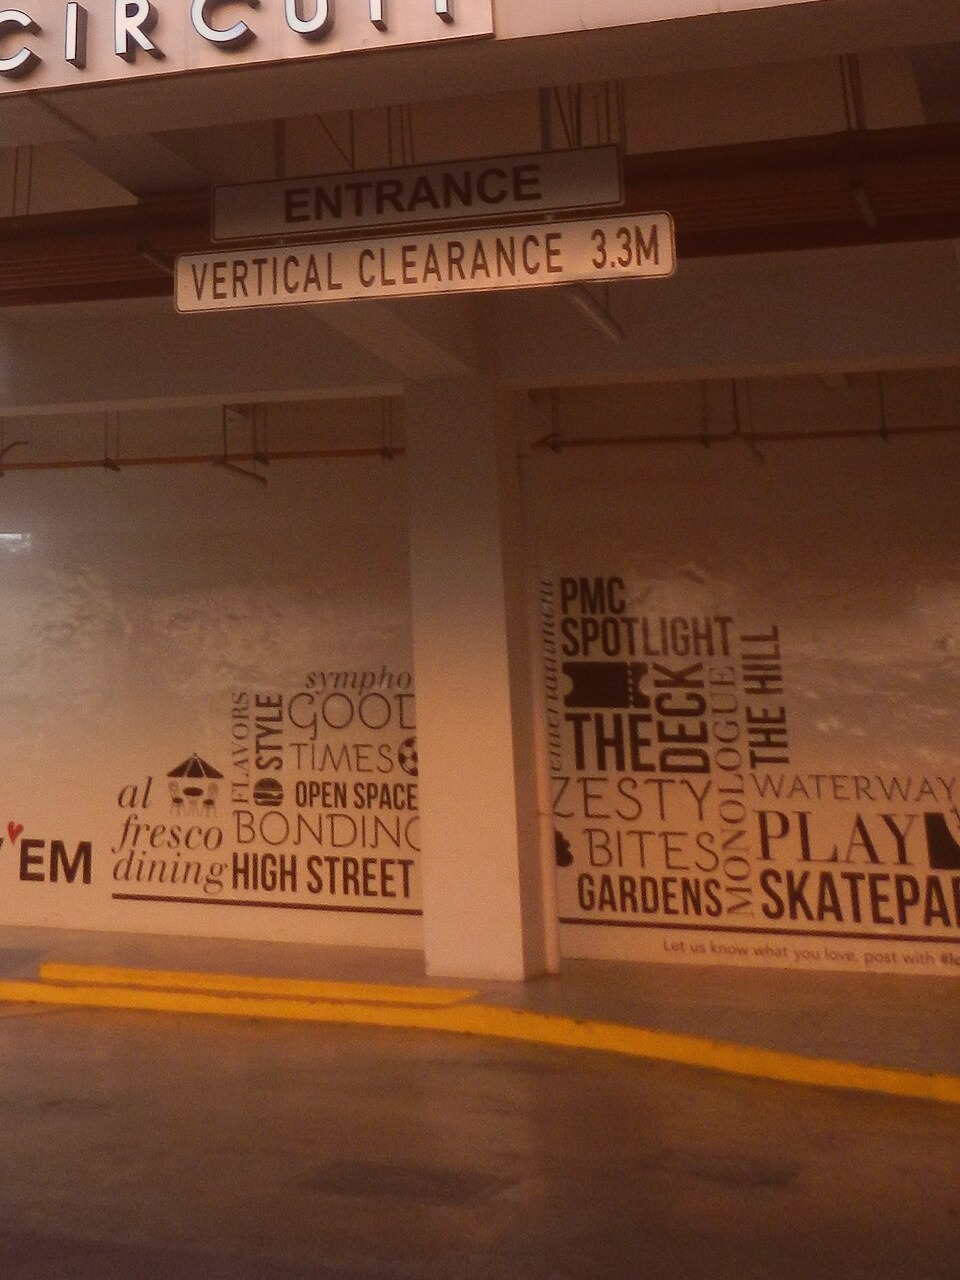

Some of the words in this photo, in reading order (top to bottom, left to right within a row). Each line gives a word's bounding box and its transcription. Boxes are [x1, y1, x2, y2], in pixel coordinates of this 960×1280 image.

[284, 165, 542, 222] ENTRANCE
[191, 252, 343, 301] VERTICAL
[357, 232, 564, 289] CLEARANCE
[590, 224, 662, 271] 3.3M
[560, 576, 627, 615] PMC
[560, 616, 734, 657] SPOTLIGHT
[740, 624, 784, 695] HILL
[254, 693, 284, 771] STYLE
[652, 661, 712, 774] DECK
[746, 706, 790, 769] THE
[231, 691, 251, 806] FLAVORS
[288, 742, 395, 774] TIMES
[564, 712, 657, 771] THE
[117, 775, 153, 809] al
[295, 780, 348, 809] OPEN
[551, 776, 713, 822] ZESTY
[709, 666, 754, 918] MONOLOGUE
[749, 772, 957, 803] WATERWAY
[111, 813, 224, 854] fresco
[582, 828, 720, 873] BITES
[753, 808, 919, 866] PLAY
[112, 849, 229, 895] dining
[231, 851, 298, 894] HIGH
[305, 855, 416, 898] STREET
[577, 872, 723, 917] GARDENS
[759, 868, 960, 928] SKATEPA
[710, 942, 749, 956] know
[753, 945, 789, 959] what
[792, 949, 821, 963] you
[863, 951, 898, 966] post
